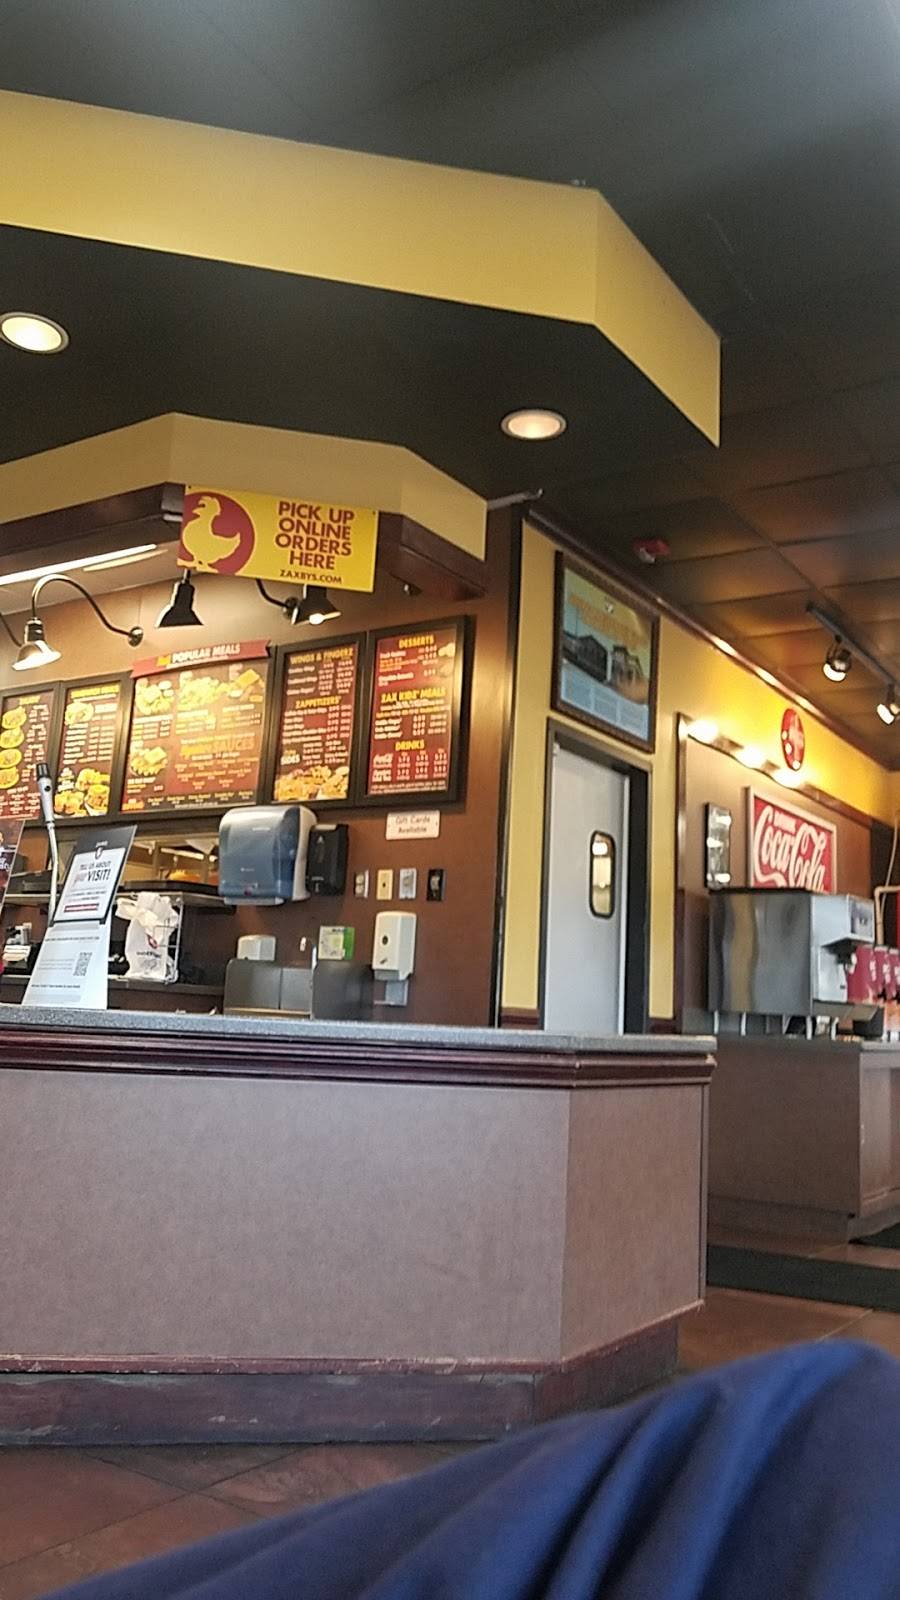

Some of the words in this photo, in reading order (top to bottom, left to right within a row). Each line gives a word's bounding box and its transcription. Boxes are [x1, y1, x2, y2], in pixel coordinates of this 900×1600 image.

[278, 501, 322, 521] PICK
[328, 508, 355, 524] UP
[278, 518, 351, 541] ONLINE
[275, 533, 352, 556] ORDERS
[289, 551, 335, 570] HERE
[280, 570, 342, 584] ZAXBYS.COM
[399, 634, 434, 649] DESSERTS
[172, 648, 211, 662] POPULAR
[211, 644, 241, 658] MEALS
[381, 692, 397, 704] ZAX
[420, 686, 446, 699] MEALS
[395, 739, 425, 752] DRINKS
[87, 868, 112, 882] VISIT!
